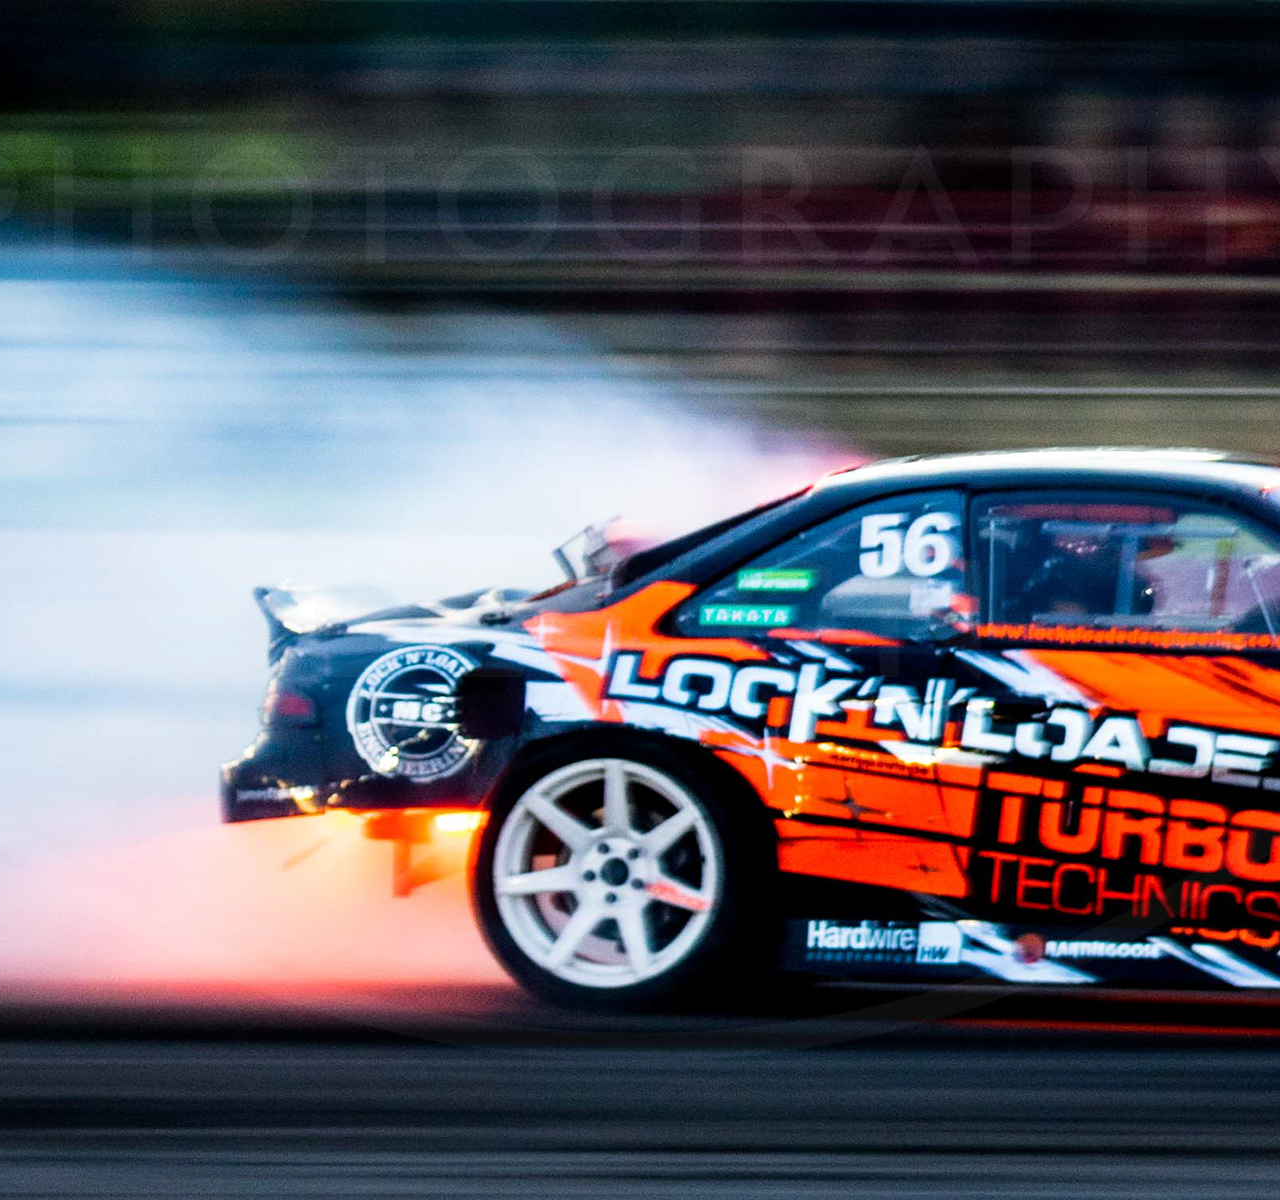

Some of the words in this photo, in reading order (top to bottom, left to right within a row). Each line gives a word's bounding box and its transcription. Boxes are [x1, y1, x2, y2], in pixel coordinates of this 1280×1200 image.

[859, 512, 958, 578] 56
[807, 920, 916, 950] Hardwire
[920, 946, 949, 960] HW
